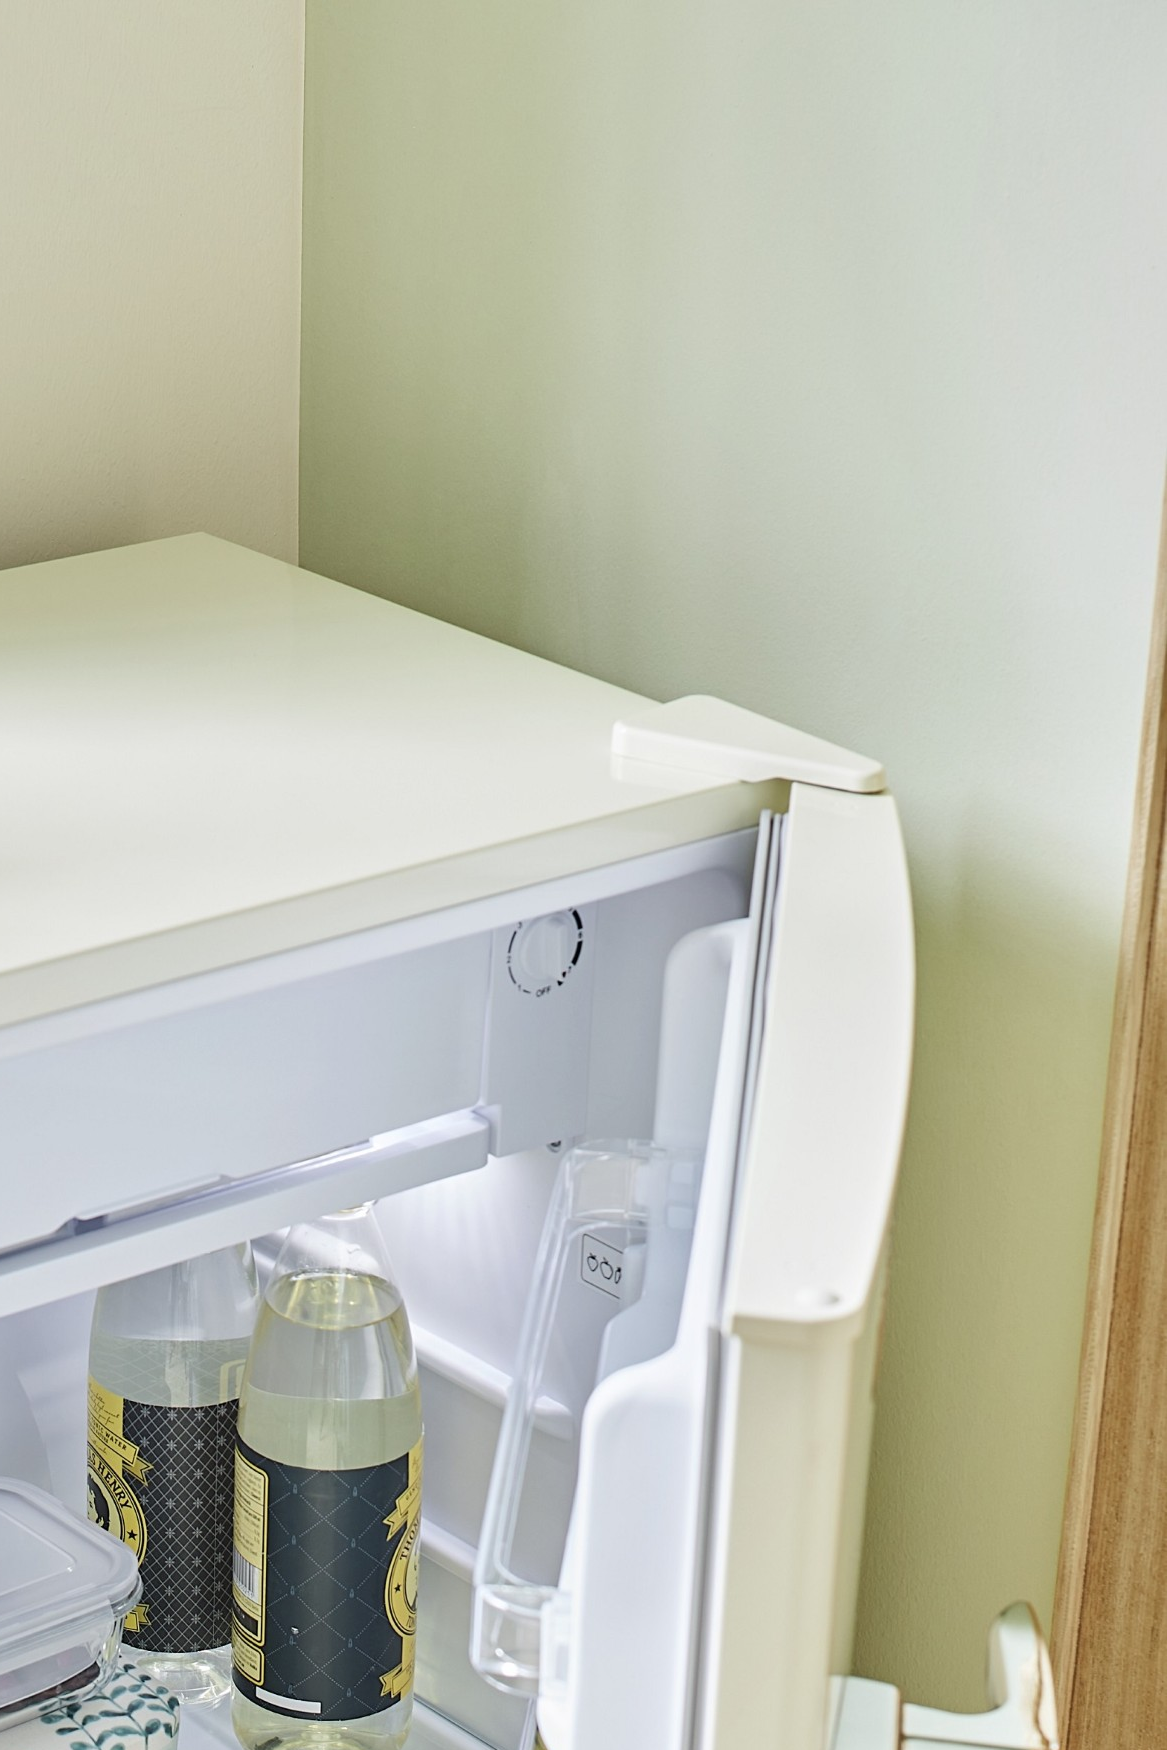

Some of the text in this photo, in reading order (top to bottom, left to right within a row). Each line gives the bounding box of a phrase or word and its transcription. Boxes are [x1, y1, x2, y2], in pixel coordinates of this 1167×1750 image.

[536, 985, 551, 997] OFF
[105, 1432, 127, 1451] WATER
[97, 1461, 132, 1508] HENRY
